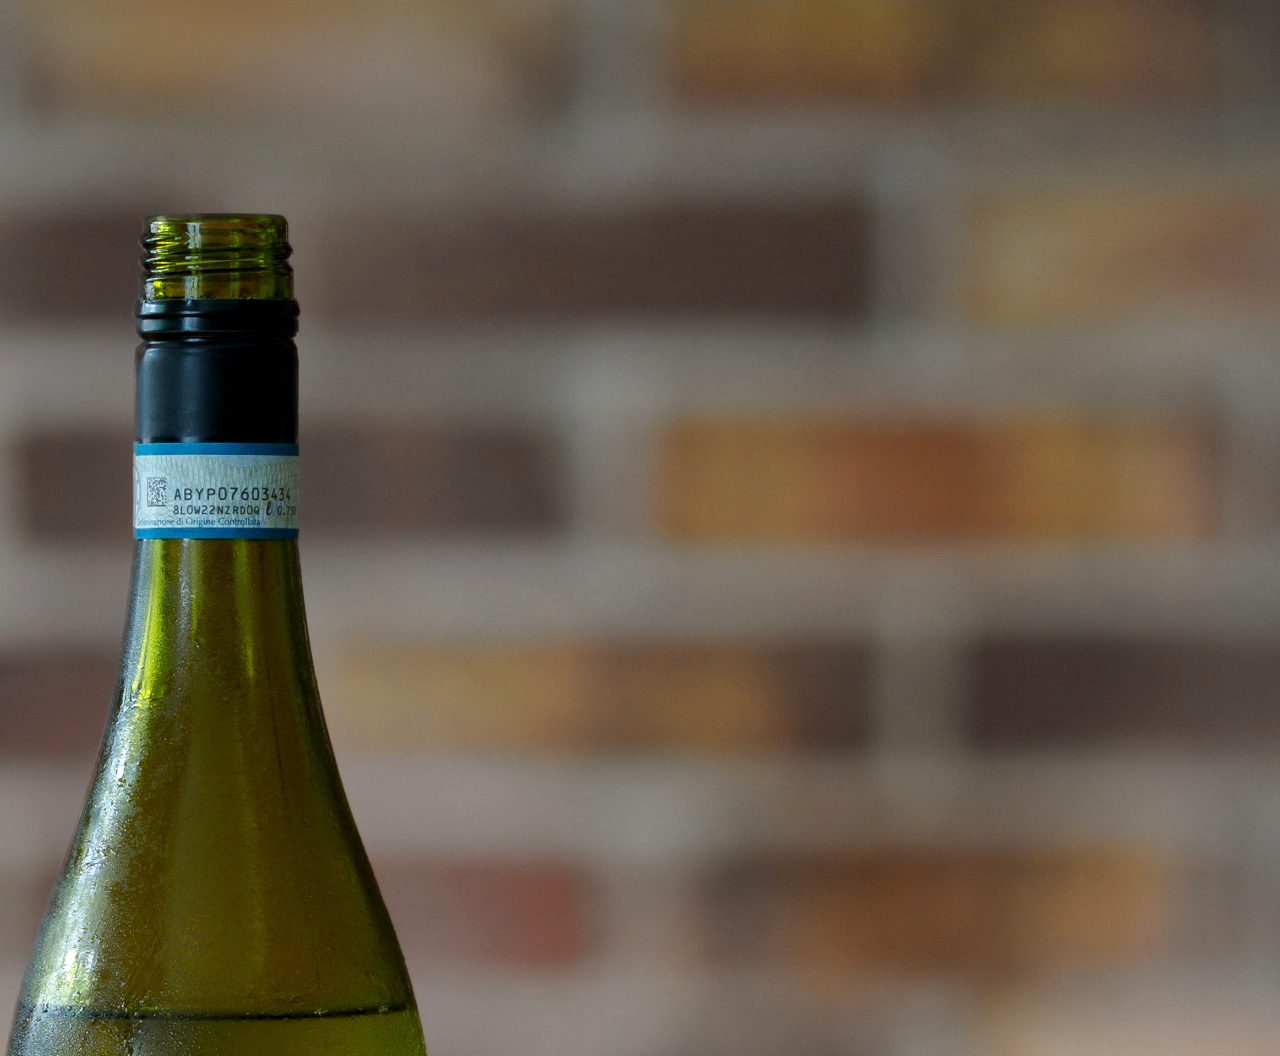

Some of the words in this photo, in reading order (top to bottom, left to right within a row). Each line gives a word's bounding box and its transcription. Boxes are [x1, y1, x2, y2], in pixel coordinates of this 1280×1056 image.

[176, 517, 184, 526] di
[185, 517, 216, 527] Origine
[218, 517, 261, 526] Controllata
